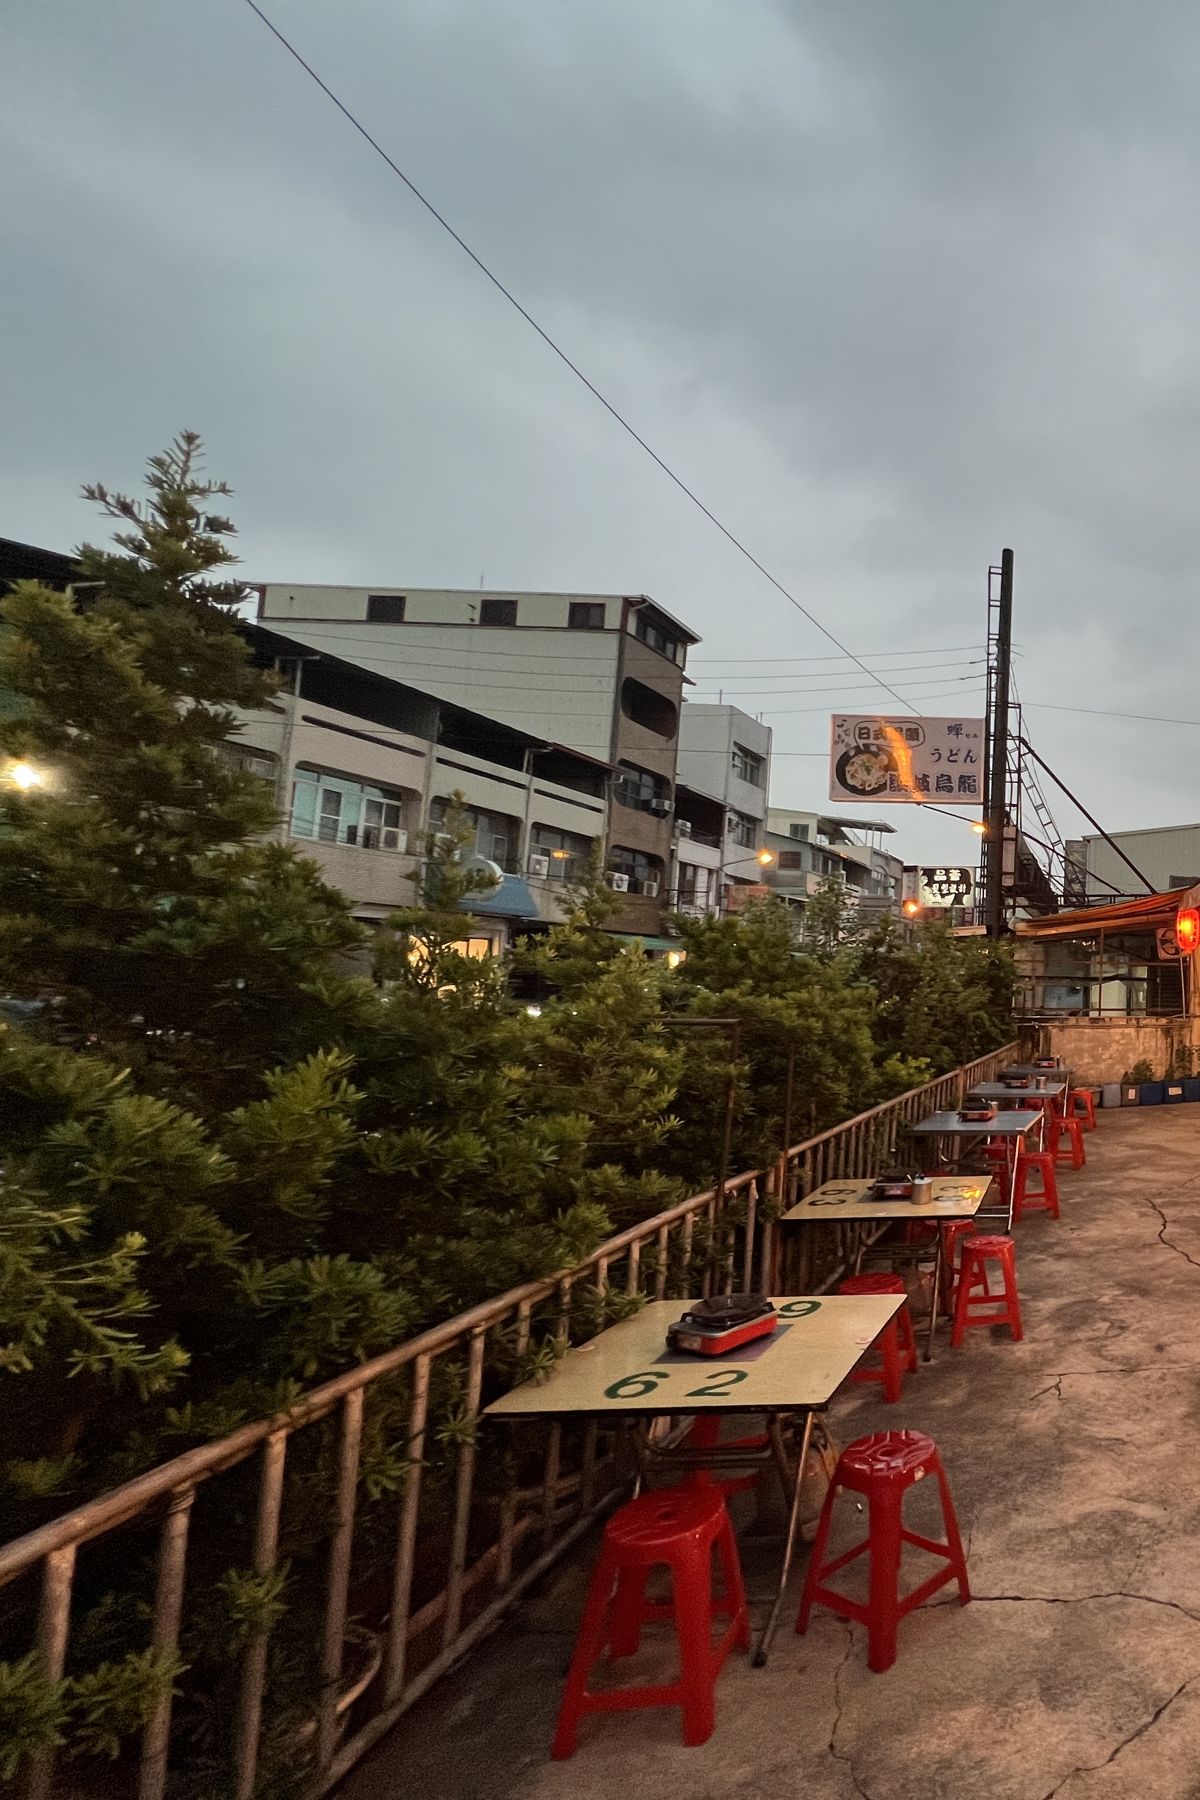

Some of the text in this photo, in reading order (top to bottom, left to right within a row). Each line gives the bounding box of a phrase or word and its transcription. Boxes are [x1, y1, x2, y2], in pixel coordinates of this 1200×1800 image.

[930, 748, 977, 763] うどん
[604, 1369, 748, 1399] 62
